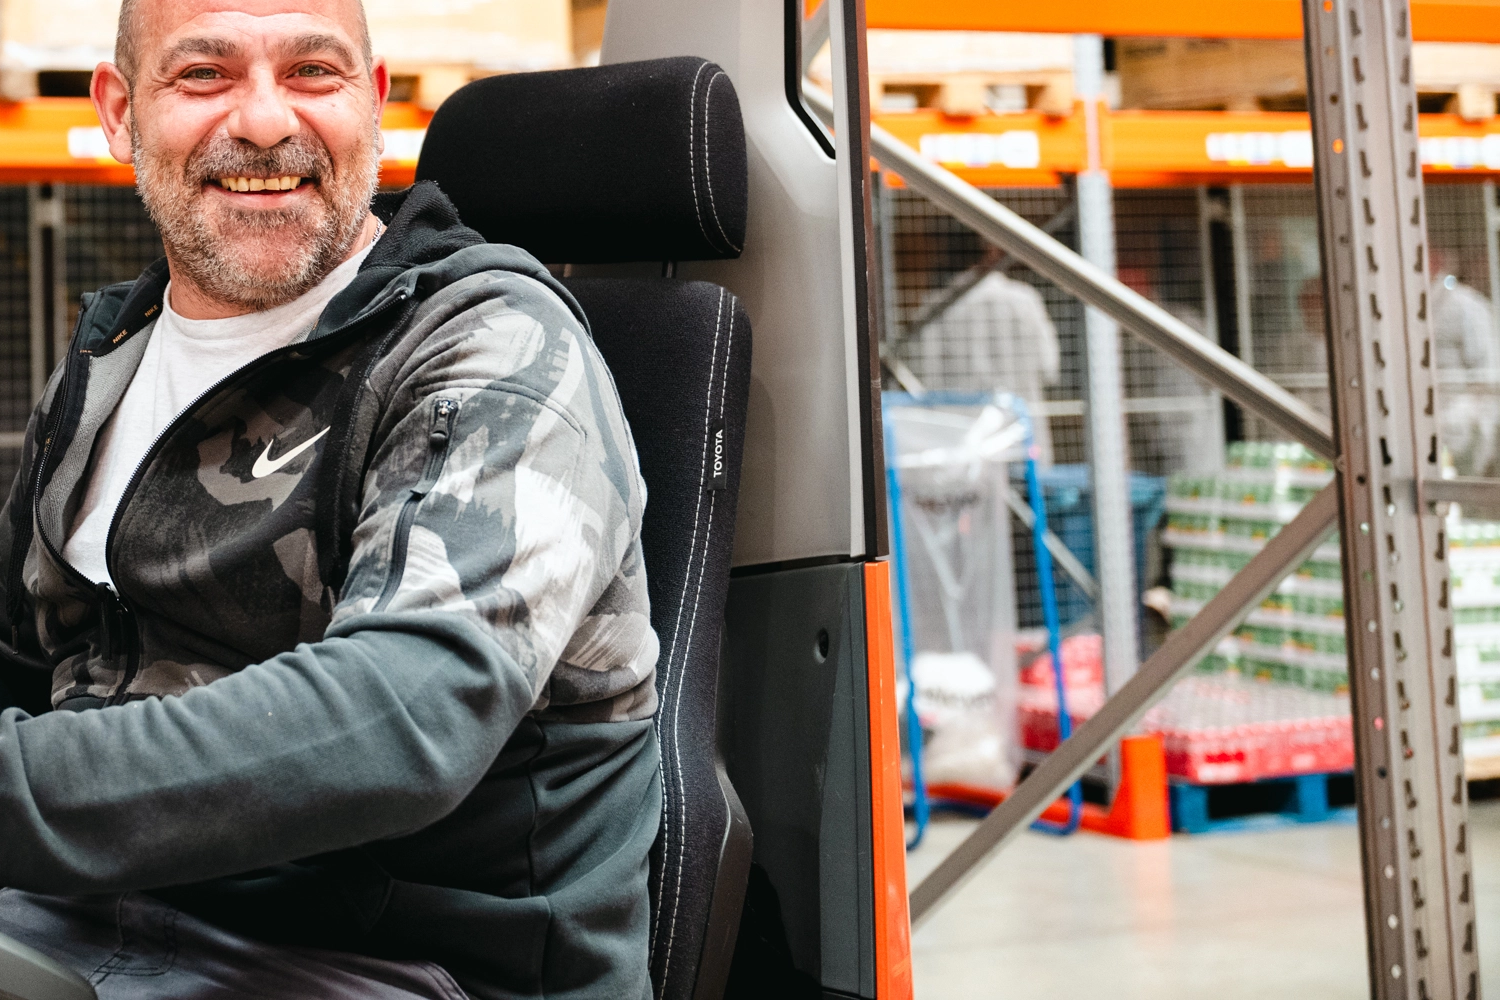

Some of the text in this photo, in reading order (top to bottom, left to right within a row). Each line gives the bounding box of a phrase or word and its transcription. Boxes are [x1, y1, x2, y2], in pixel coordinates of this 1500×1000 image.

[144, 304, 159, 318] NIKE
[112, 328, 128, 344] NIKE
[713, 429, 723, 478] TOYOTA
